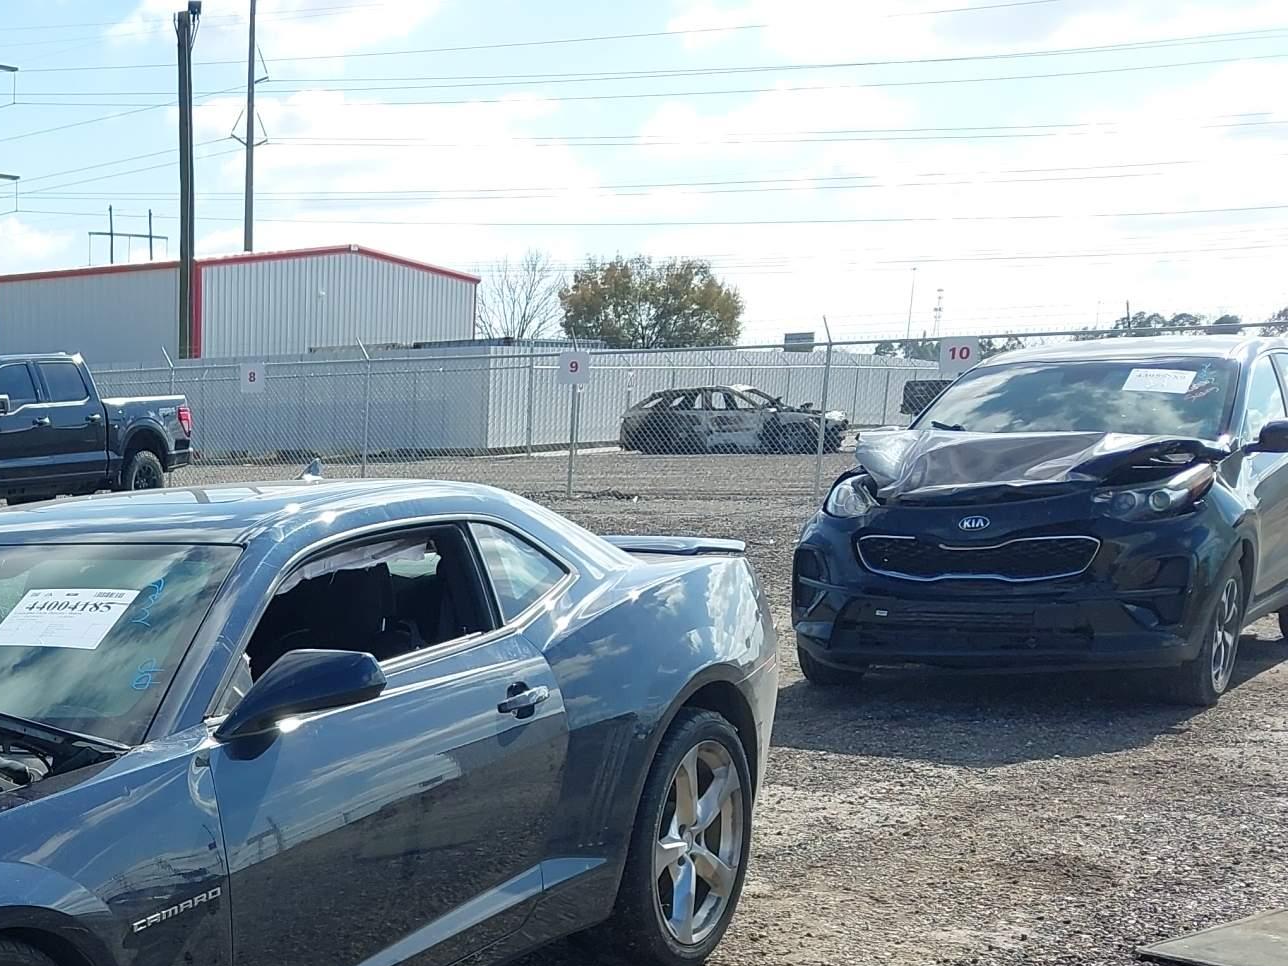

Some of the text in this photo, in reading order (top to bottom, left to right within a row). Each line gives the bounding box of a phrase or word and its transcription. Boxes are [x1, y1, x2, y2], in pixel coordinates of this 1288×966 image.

[949, 346, 970, 360] 10
[569, 361, 578, 373] 9
[248, 371, 256, 382] 8
[963, 518, 985, 529] KIA
[25, 600, 112, 613] 44004185
[132, 887, 221, 932] CAMARO
